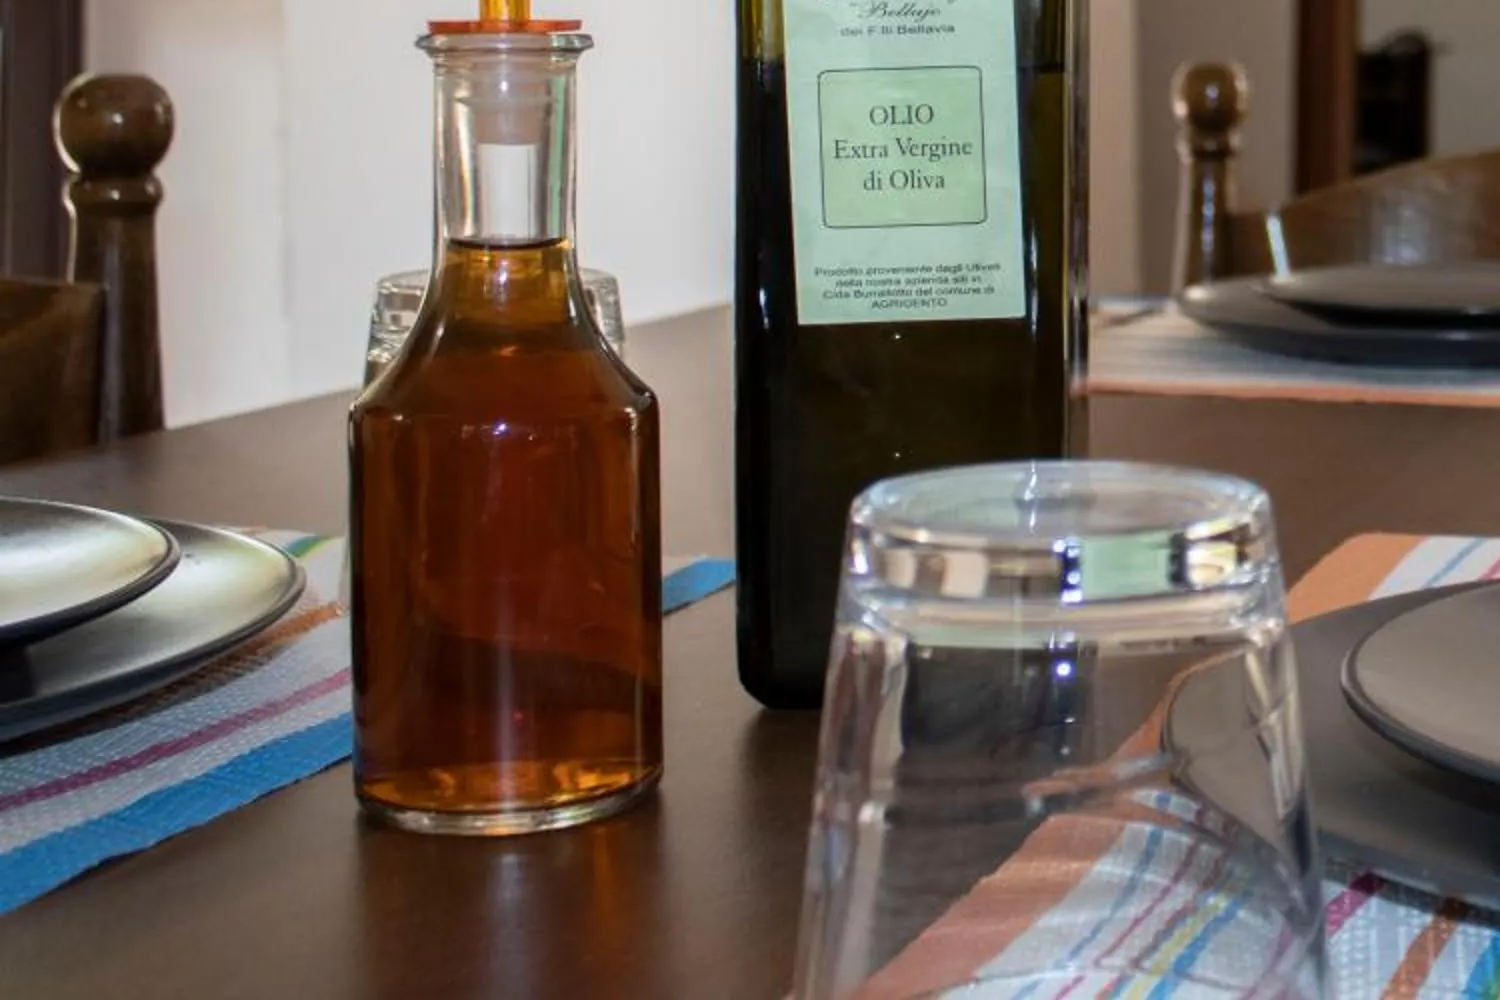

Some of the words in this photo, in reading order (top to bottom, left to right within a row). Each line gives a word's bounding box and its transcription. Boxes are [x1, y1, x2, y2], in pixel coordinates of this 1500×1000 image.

[869, 103, 934, 125] OLIO
[834, 138, 889, 159] Extra
[895, 136, 973, 162] Vergine
[863, 170, 883, 191] di
[889, 168, 945, 190] Oliva
[871, 299, 948, 310] AGRIGENTO
